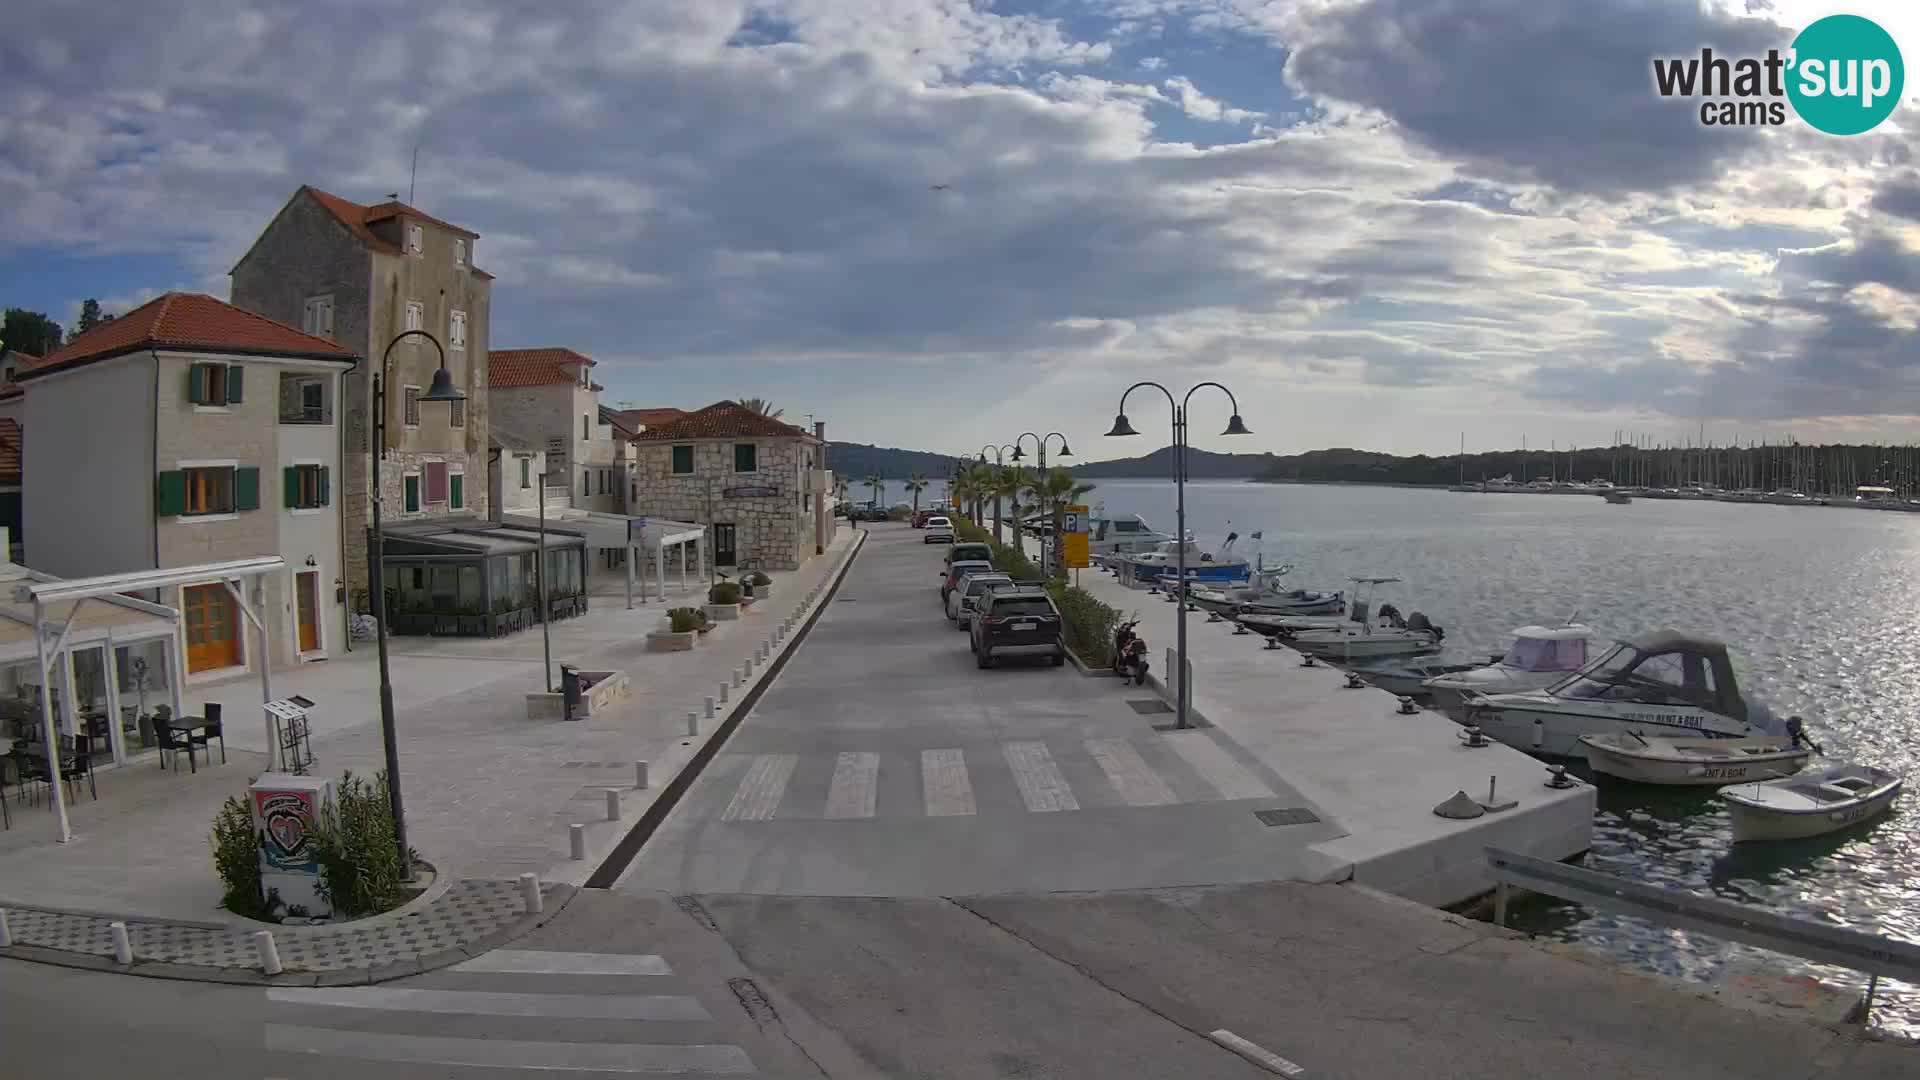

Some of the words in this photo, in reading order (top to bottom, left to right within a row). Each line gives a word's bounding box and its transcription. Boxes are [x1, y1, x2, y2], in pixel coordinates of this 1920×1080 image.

[1065, 514, 1076, 531] P
[1656, 713, 1676, 725] RENT
[1684, 715, 1704, 728] BOAT
[1704, 768, 1719, 778] ENT
[1727, 767, 1747, 778] BOAT
